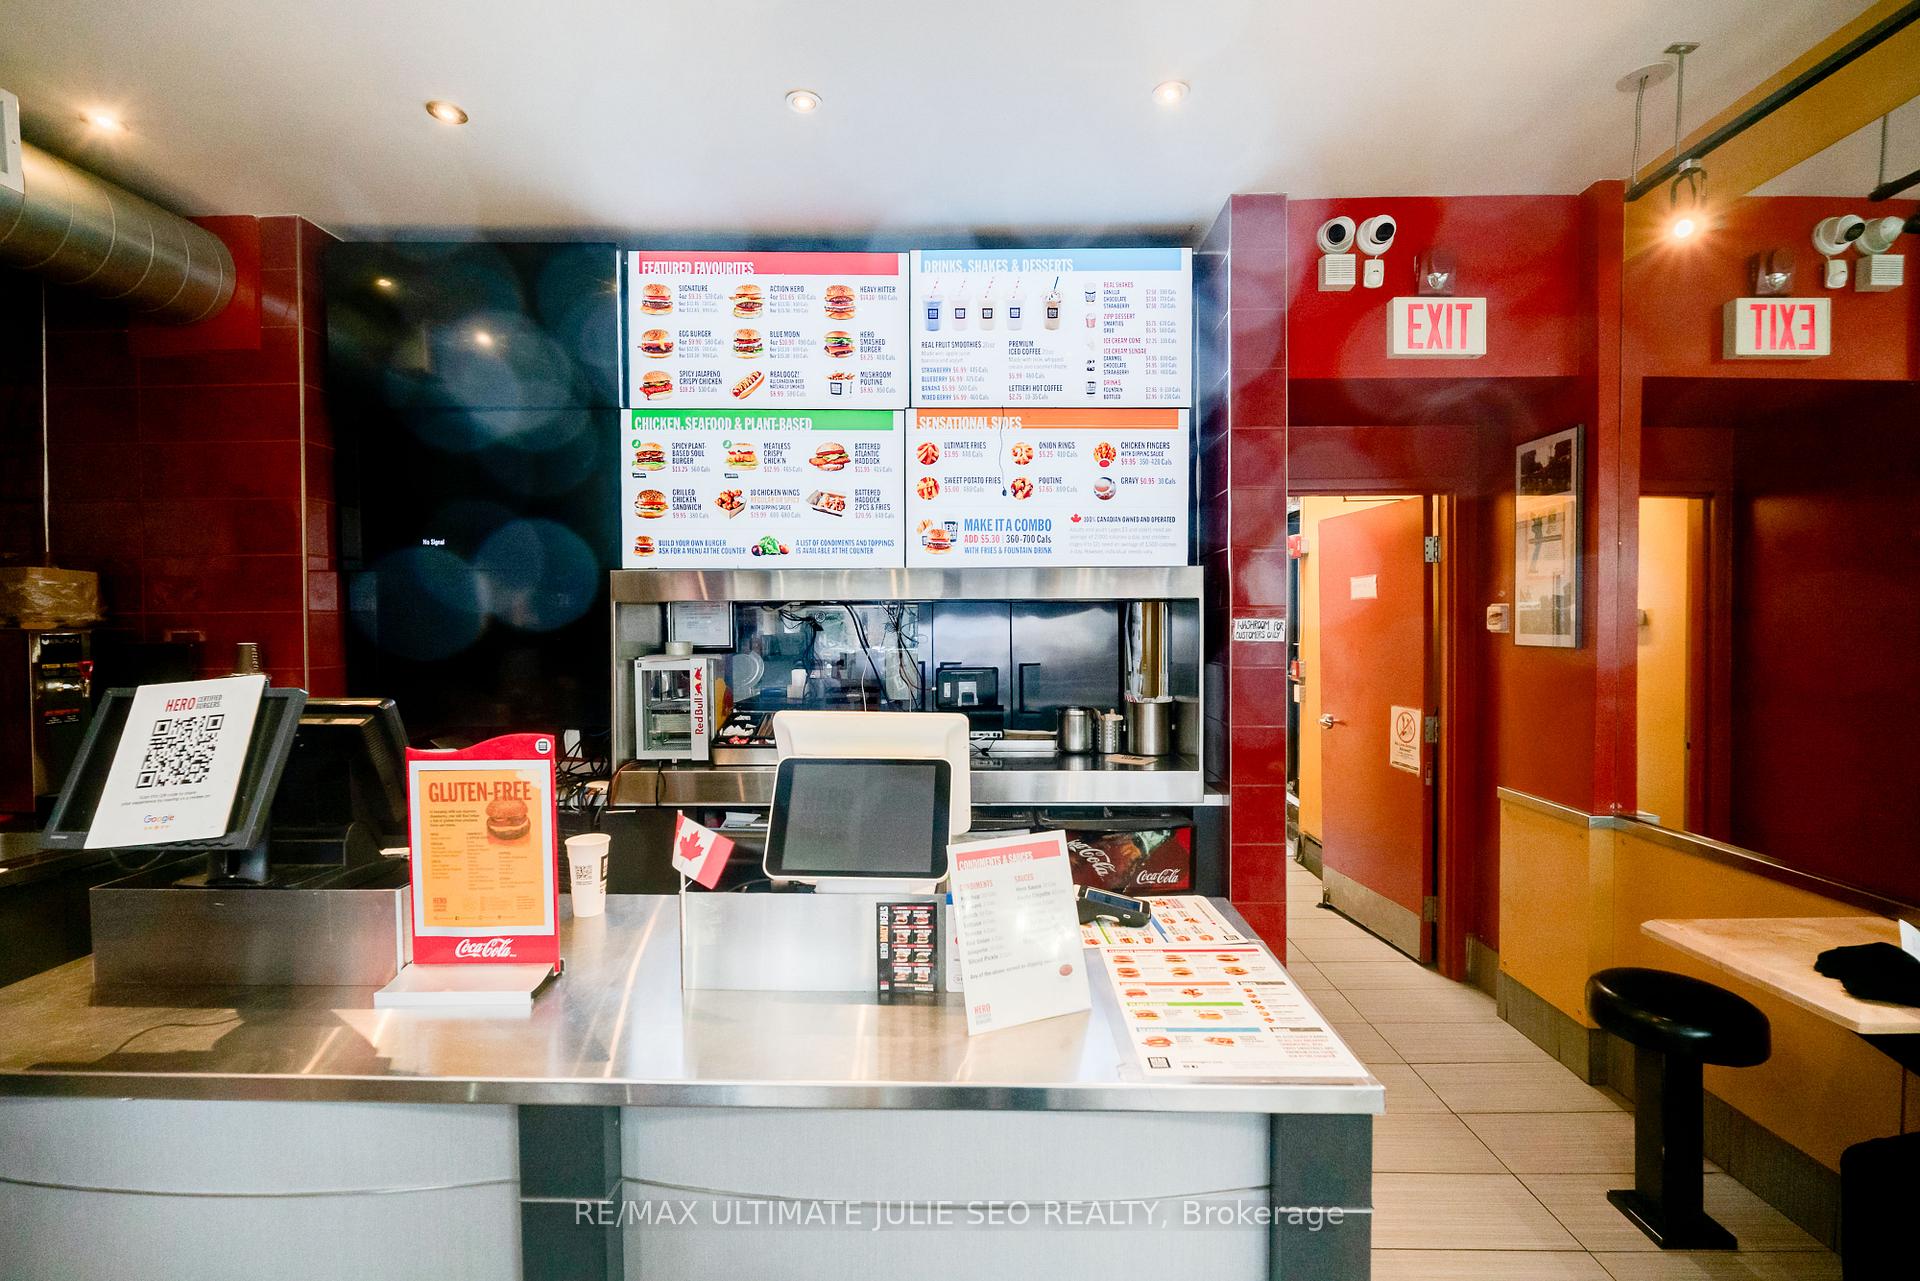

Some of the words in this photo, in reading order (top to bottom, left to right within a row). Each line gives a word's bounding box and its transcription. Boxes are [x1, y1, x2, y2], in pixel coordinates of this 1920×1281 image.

[642, 261, 691, 275] FEATURED
[695, 261, 755, 275] FAVOURITES
[968, 259, 1008, 273] SHAKES
[1011, 259, 1019, 272] &
[1023, 258, 1073, 272] DESSERTS
[679, 284, 708, 292] SIGNATURE
[860, 285, 876, 293] HEAVY
[877, 285, 896, 293] HITTER
[1407, 304, 1472, 350] EXIT
[690, 330, 711, 338] BURGER
[770, 330, 783, 338] BLUE
[784, 330, 801, 338] MOON
[951, 340, 982, 348] SMOOTHIES
[679, 377, 698, 385] CRISPY
[699, 377, 722, 385] CHICKEN
[1032, 384, 1043, 392] HOT
[1043, 384, 1063, 392] COFFEE
[685, 416, 732, 431] SEAFOOD
[734, 417, 742, 430] &
[744, 417, 812, 430] PLANT-BASED
[919, 416, 988, 429] SENSATIONAL
[991, 416, 1022, 429] SIDES
[763, 442, 791, 450] MEATLESS
[854, 442, 880, 450] BATTERED
[944, 441, 969, 449] ULTIMATE
[970, 441, 987, 449] FRIES
[1038, 441, 1056, 449] ONION
[1057, 441, 1075, 449] RINGS
[1120, 441, 1145, 449] CHICKEN
[1146, 441, 1170, 449] FINGERS
[944, 476, 962, 484] SWEET
[963, 476, 985, 484] POTATO
[985, 476, 1002, 484] FRIES
[1038, 476, 1062, 484] POUTINE
[1120, 476, 1138, 485] GRAVY
[672, 488, 696, 496] GRILLED
[756, 488, 782, 496] CHICKEN
[782, 488, 801, 496] WINGS
[854, 488, 881, 496] BATTERED
[672, 503, 702, 511] SANDWICH
[964, 518, 993, 532] MAKE
[995, 518, 1005, 532] IT
[1006, 518, 1013, 532] A
[1014, 518, 1052, 532] COMBO
[422, 538, 430, 546] No
[430, 538, 446, 547] Signal
[658, 539, 674, 547] BUILD
[675, 539, 690, 547] YOUR
[690, 539, 704, 547] OWN
[704, 539, 727, 547] BURGER
[964, 534, 979, 544] ADD
[980, 534, 1000, 544] $5.30
[1006, 534, 1036, 544] 360-700
[1037, 534, 1052, 544] Cals
[964, 546, 979, 554] WITH
[980, 546, 998, 554] FRIES
[1004, 546, 1033, 554] FOUNTAIN
[1034, 546, 1052, 554] DRINK
[1273, 620, 1284, 632] FOR
[1235, 631, 1265, 639] CUSTOMERS
[165, 697, 196, 712] HERO
[694, 697, 704, 716] Bull
[694, 716, 704, 735] Red
[428, 781, 532, 803] GLUTEN-FREE
[143, 814, 175, 824] Google
[1136, 868, 1181, 885] Coca-Cola
[880, 905, 889, 925] DEALS
[455, 938, 514, 958] Coca-Cola
